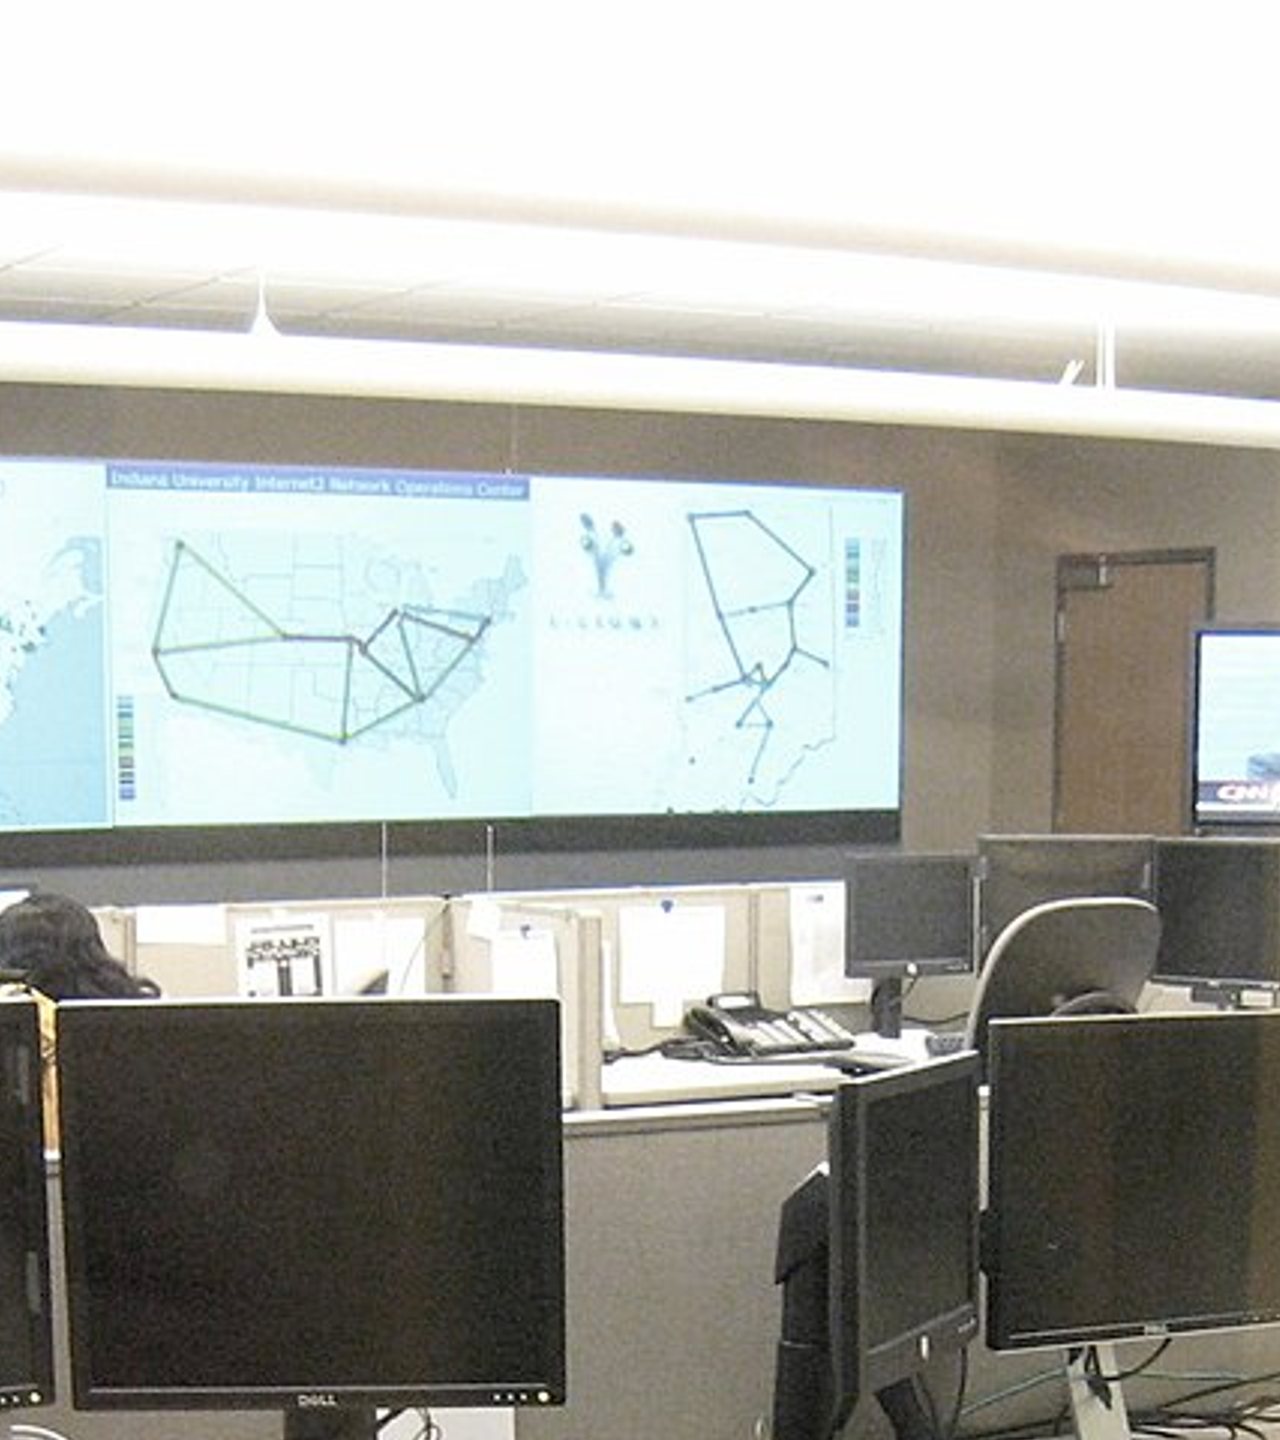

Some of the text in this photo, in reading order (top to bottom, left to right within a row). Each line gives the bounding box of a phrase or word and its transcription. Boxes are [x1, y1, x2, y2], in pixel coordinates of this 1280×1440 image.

[111, 471, 169, 487] Indiana
[172, 472, 251, 492] University
[328, 476, 393, 493] Network
[395, 478, 474, 497] Operations
[476, 481, 526, 497] Center
[297, 1394, 338, 1407] DELL
